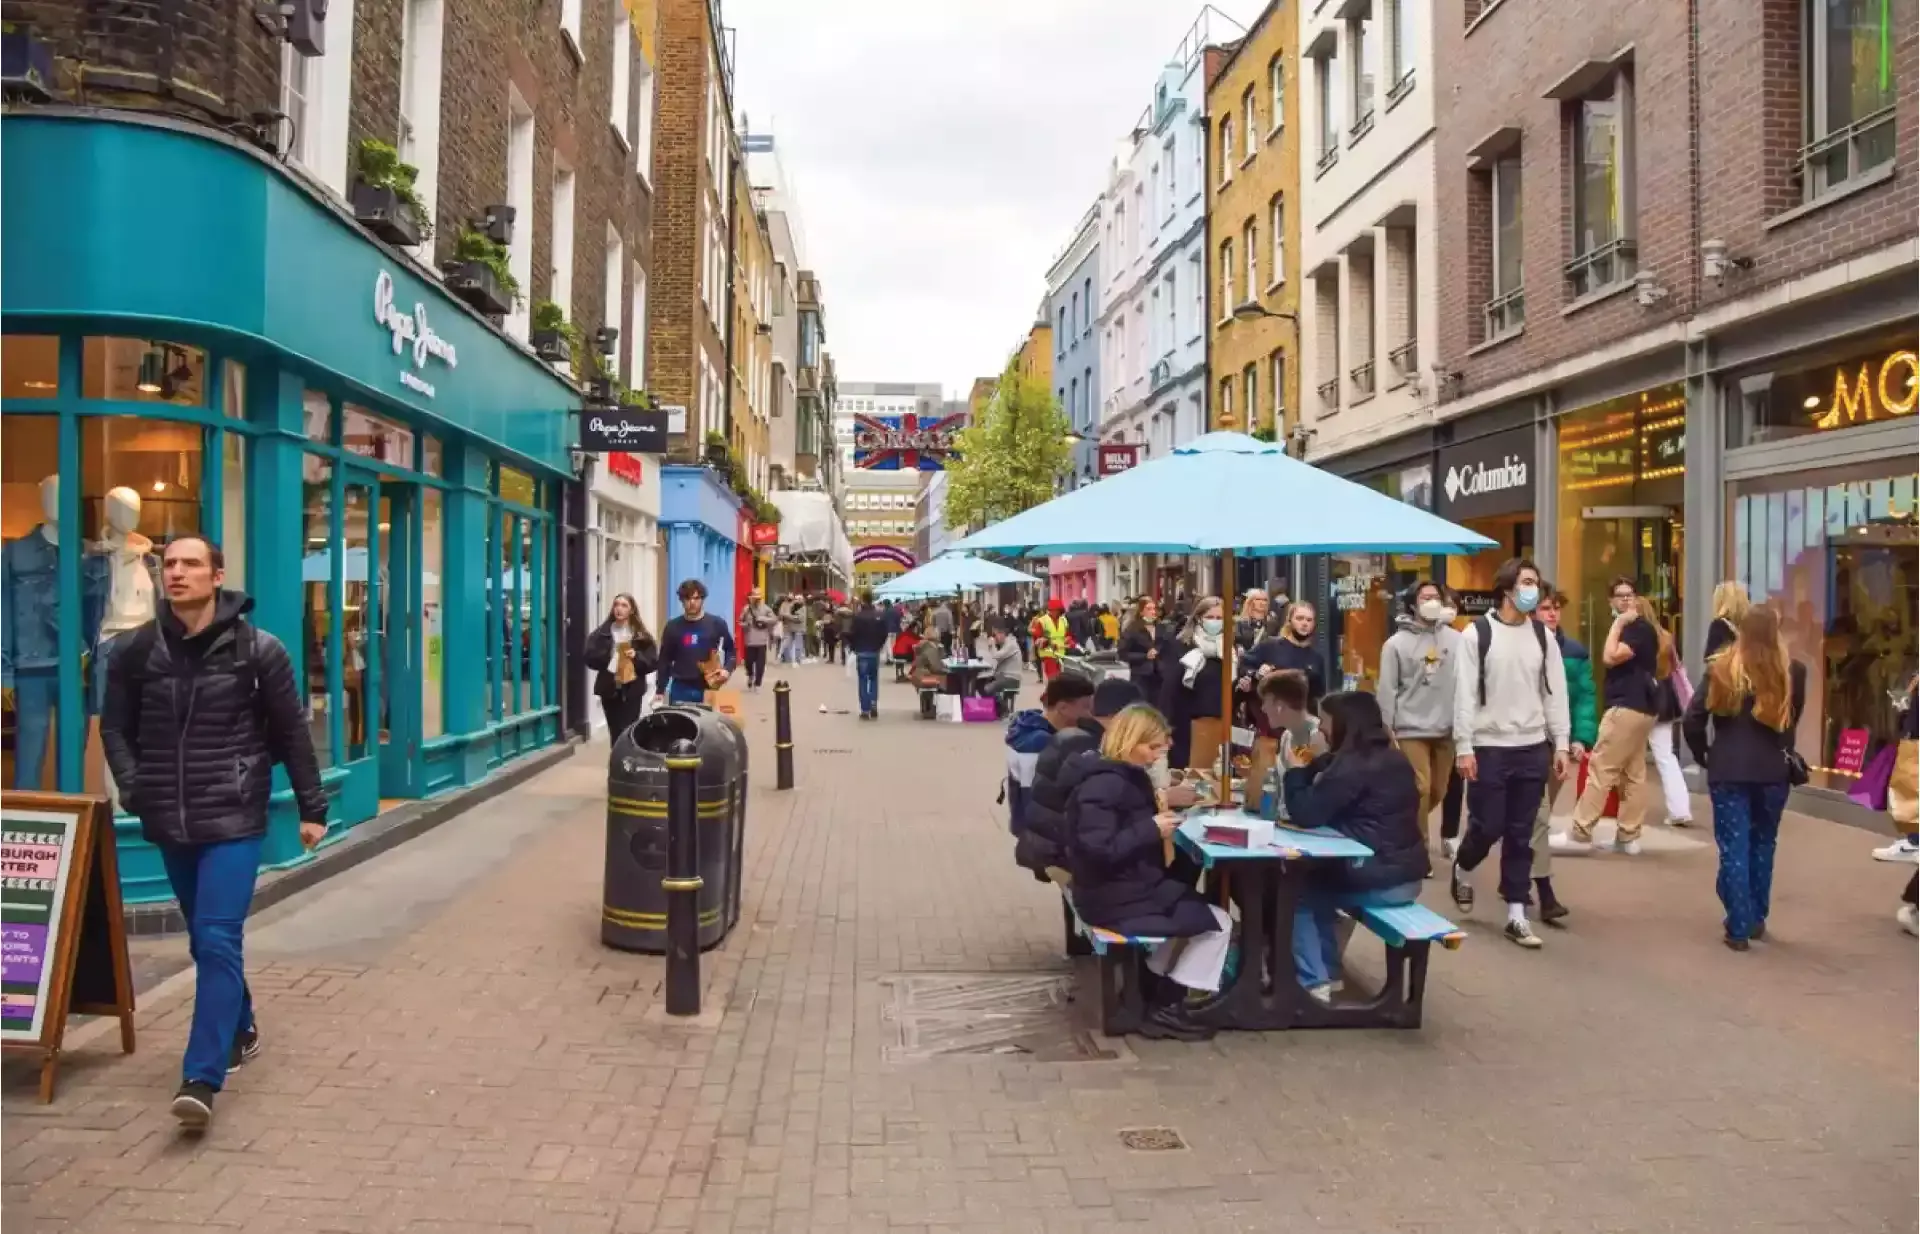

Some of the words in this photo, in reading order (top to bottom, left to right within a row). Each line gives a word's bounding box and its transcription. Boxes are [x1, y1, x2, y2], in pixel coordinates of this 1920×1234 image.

[589, 417, 619, 437] Pepe
[618, 420, 656, 437] Jeans
[1460, 453, 1526, 495] Columbia
